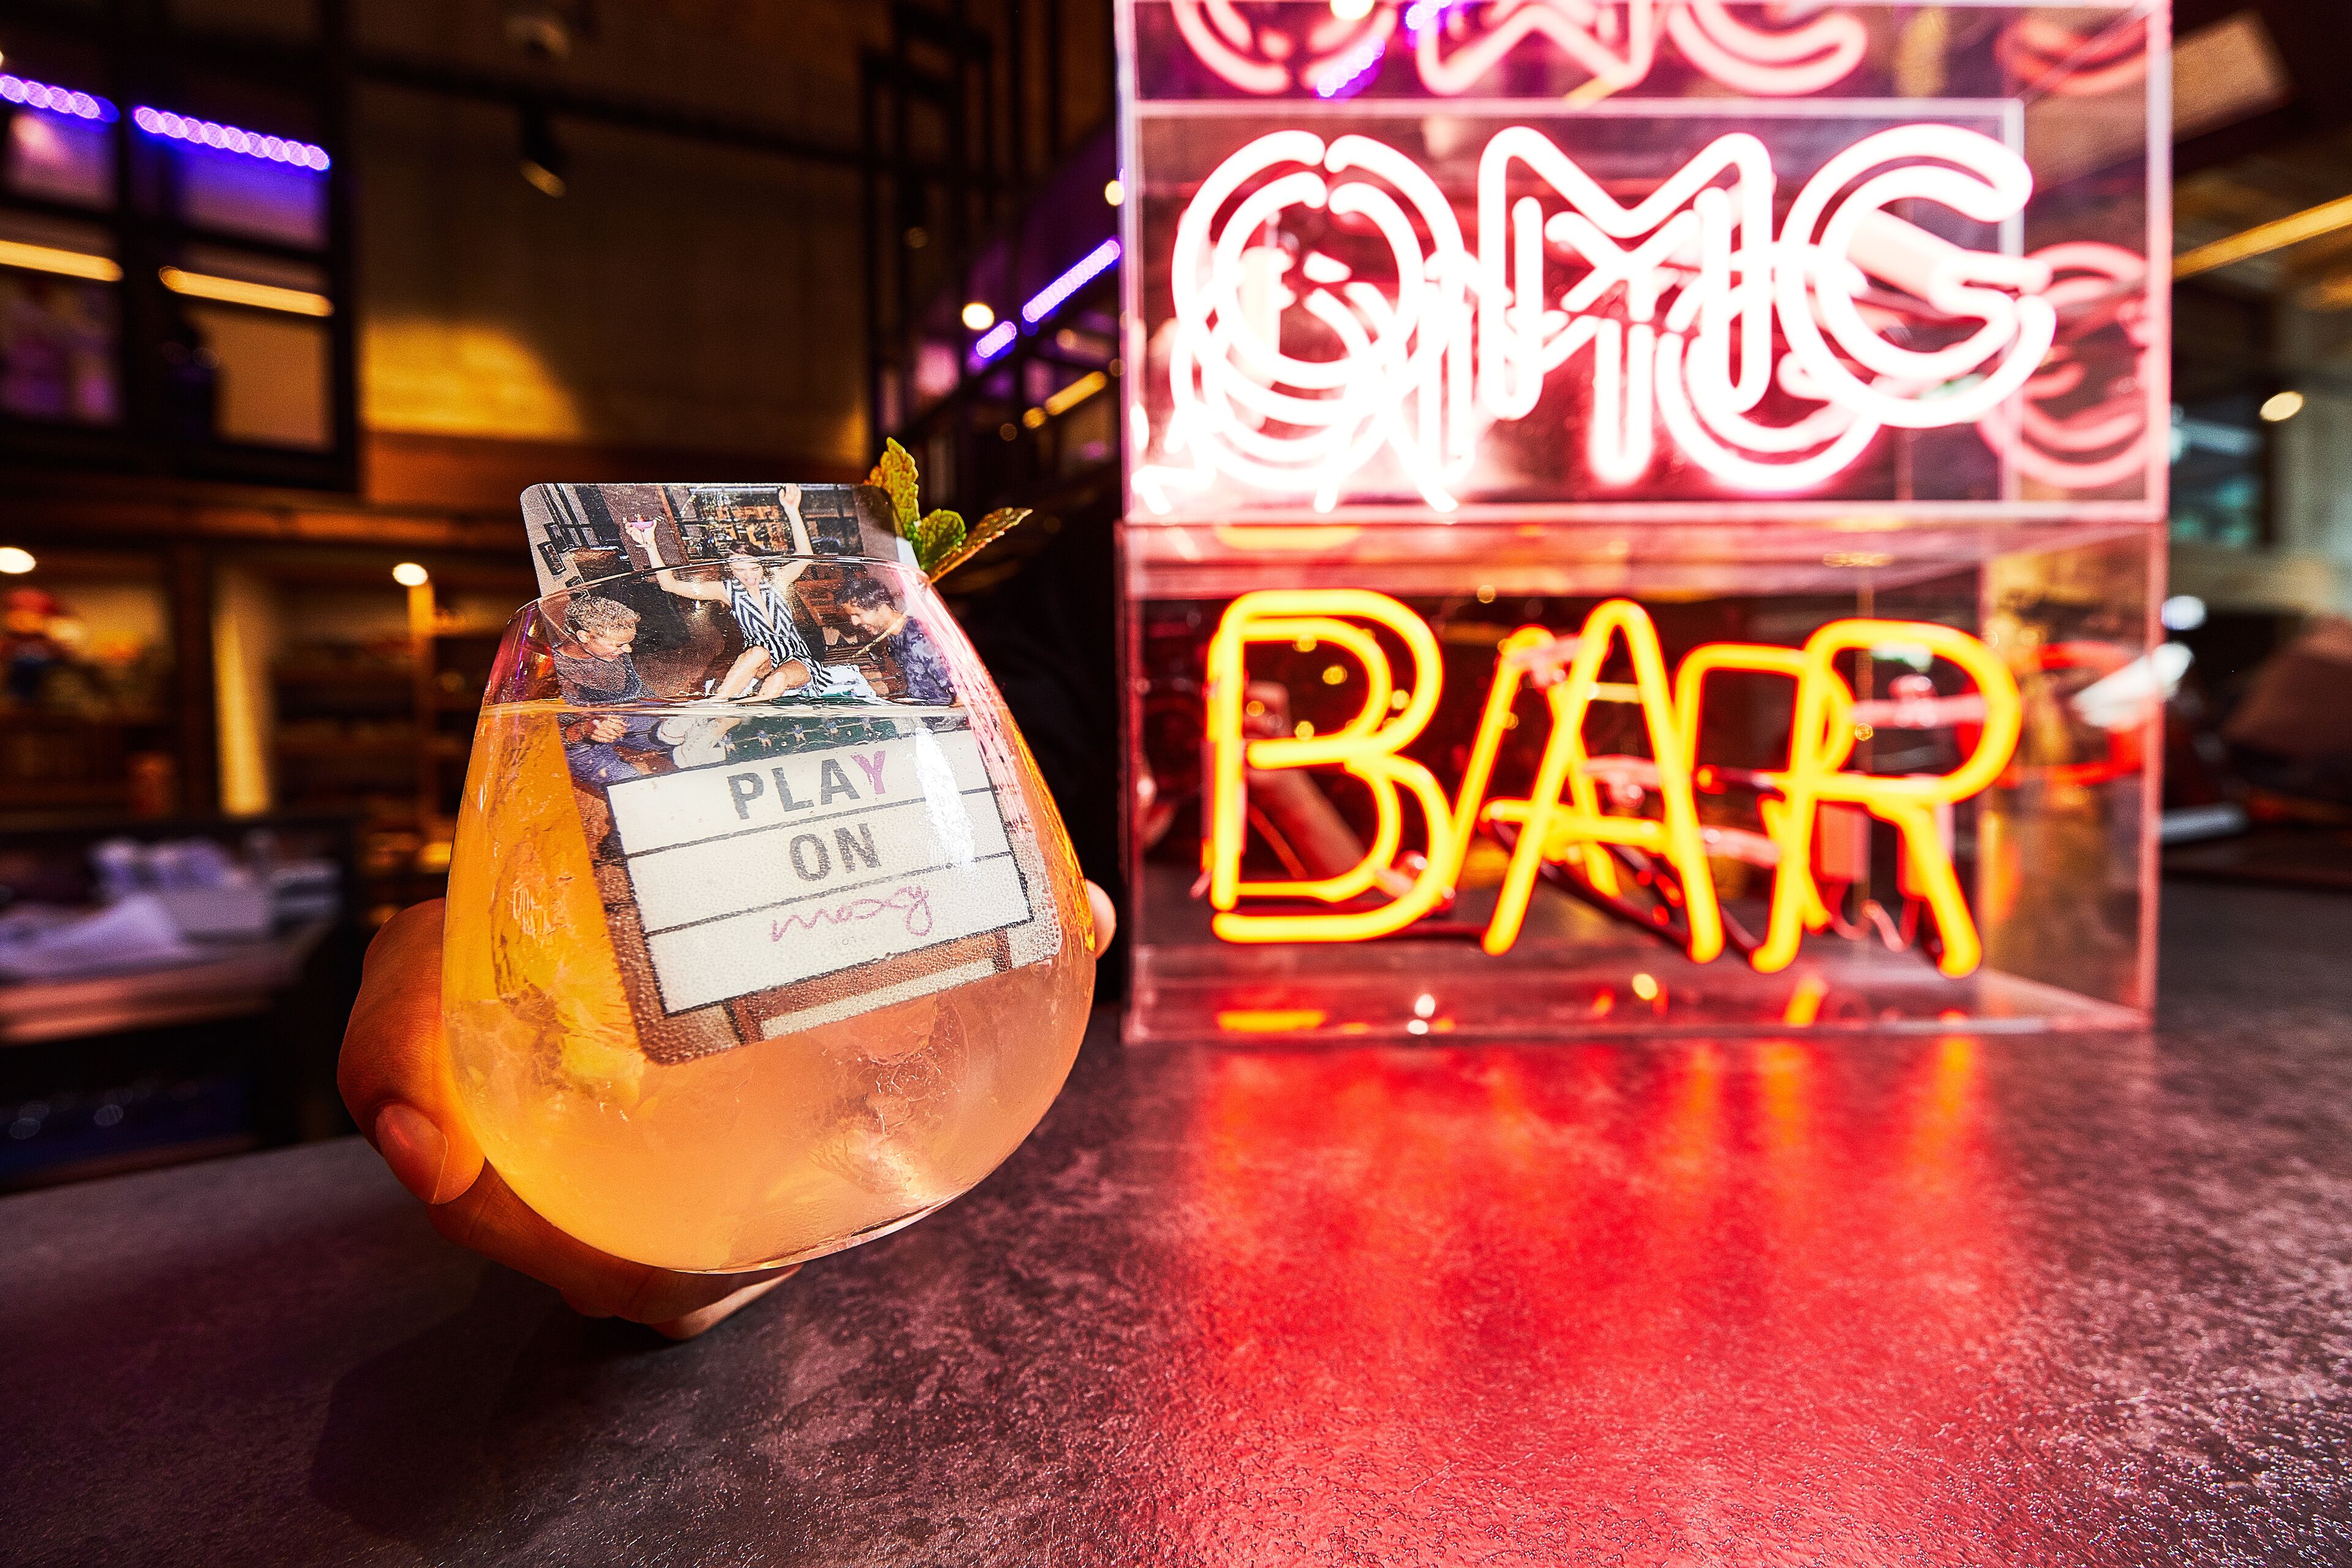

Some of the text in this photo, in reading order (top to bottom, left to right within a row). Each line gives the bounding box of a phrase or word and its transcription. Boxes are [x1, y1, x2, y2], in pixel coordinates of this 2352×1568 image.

[1171, 124, 2056, 427] OMG
[726, 750, 886, 820] PLAY
[790, 823, 881, 881] ON
[1208, 588, 2023, 976] BAR
